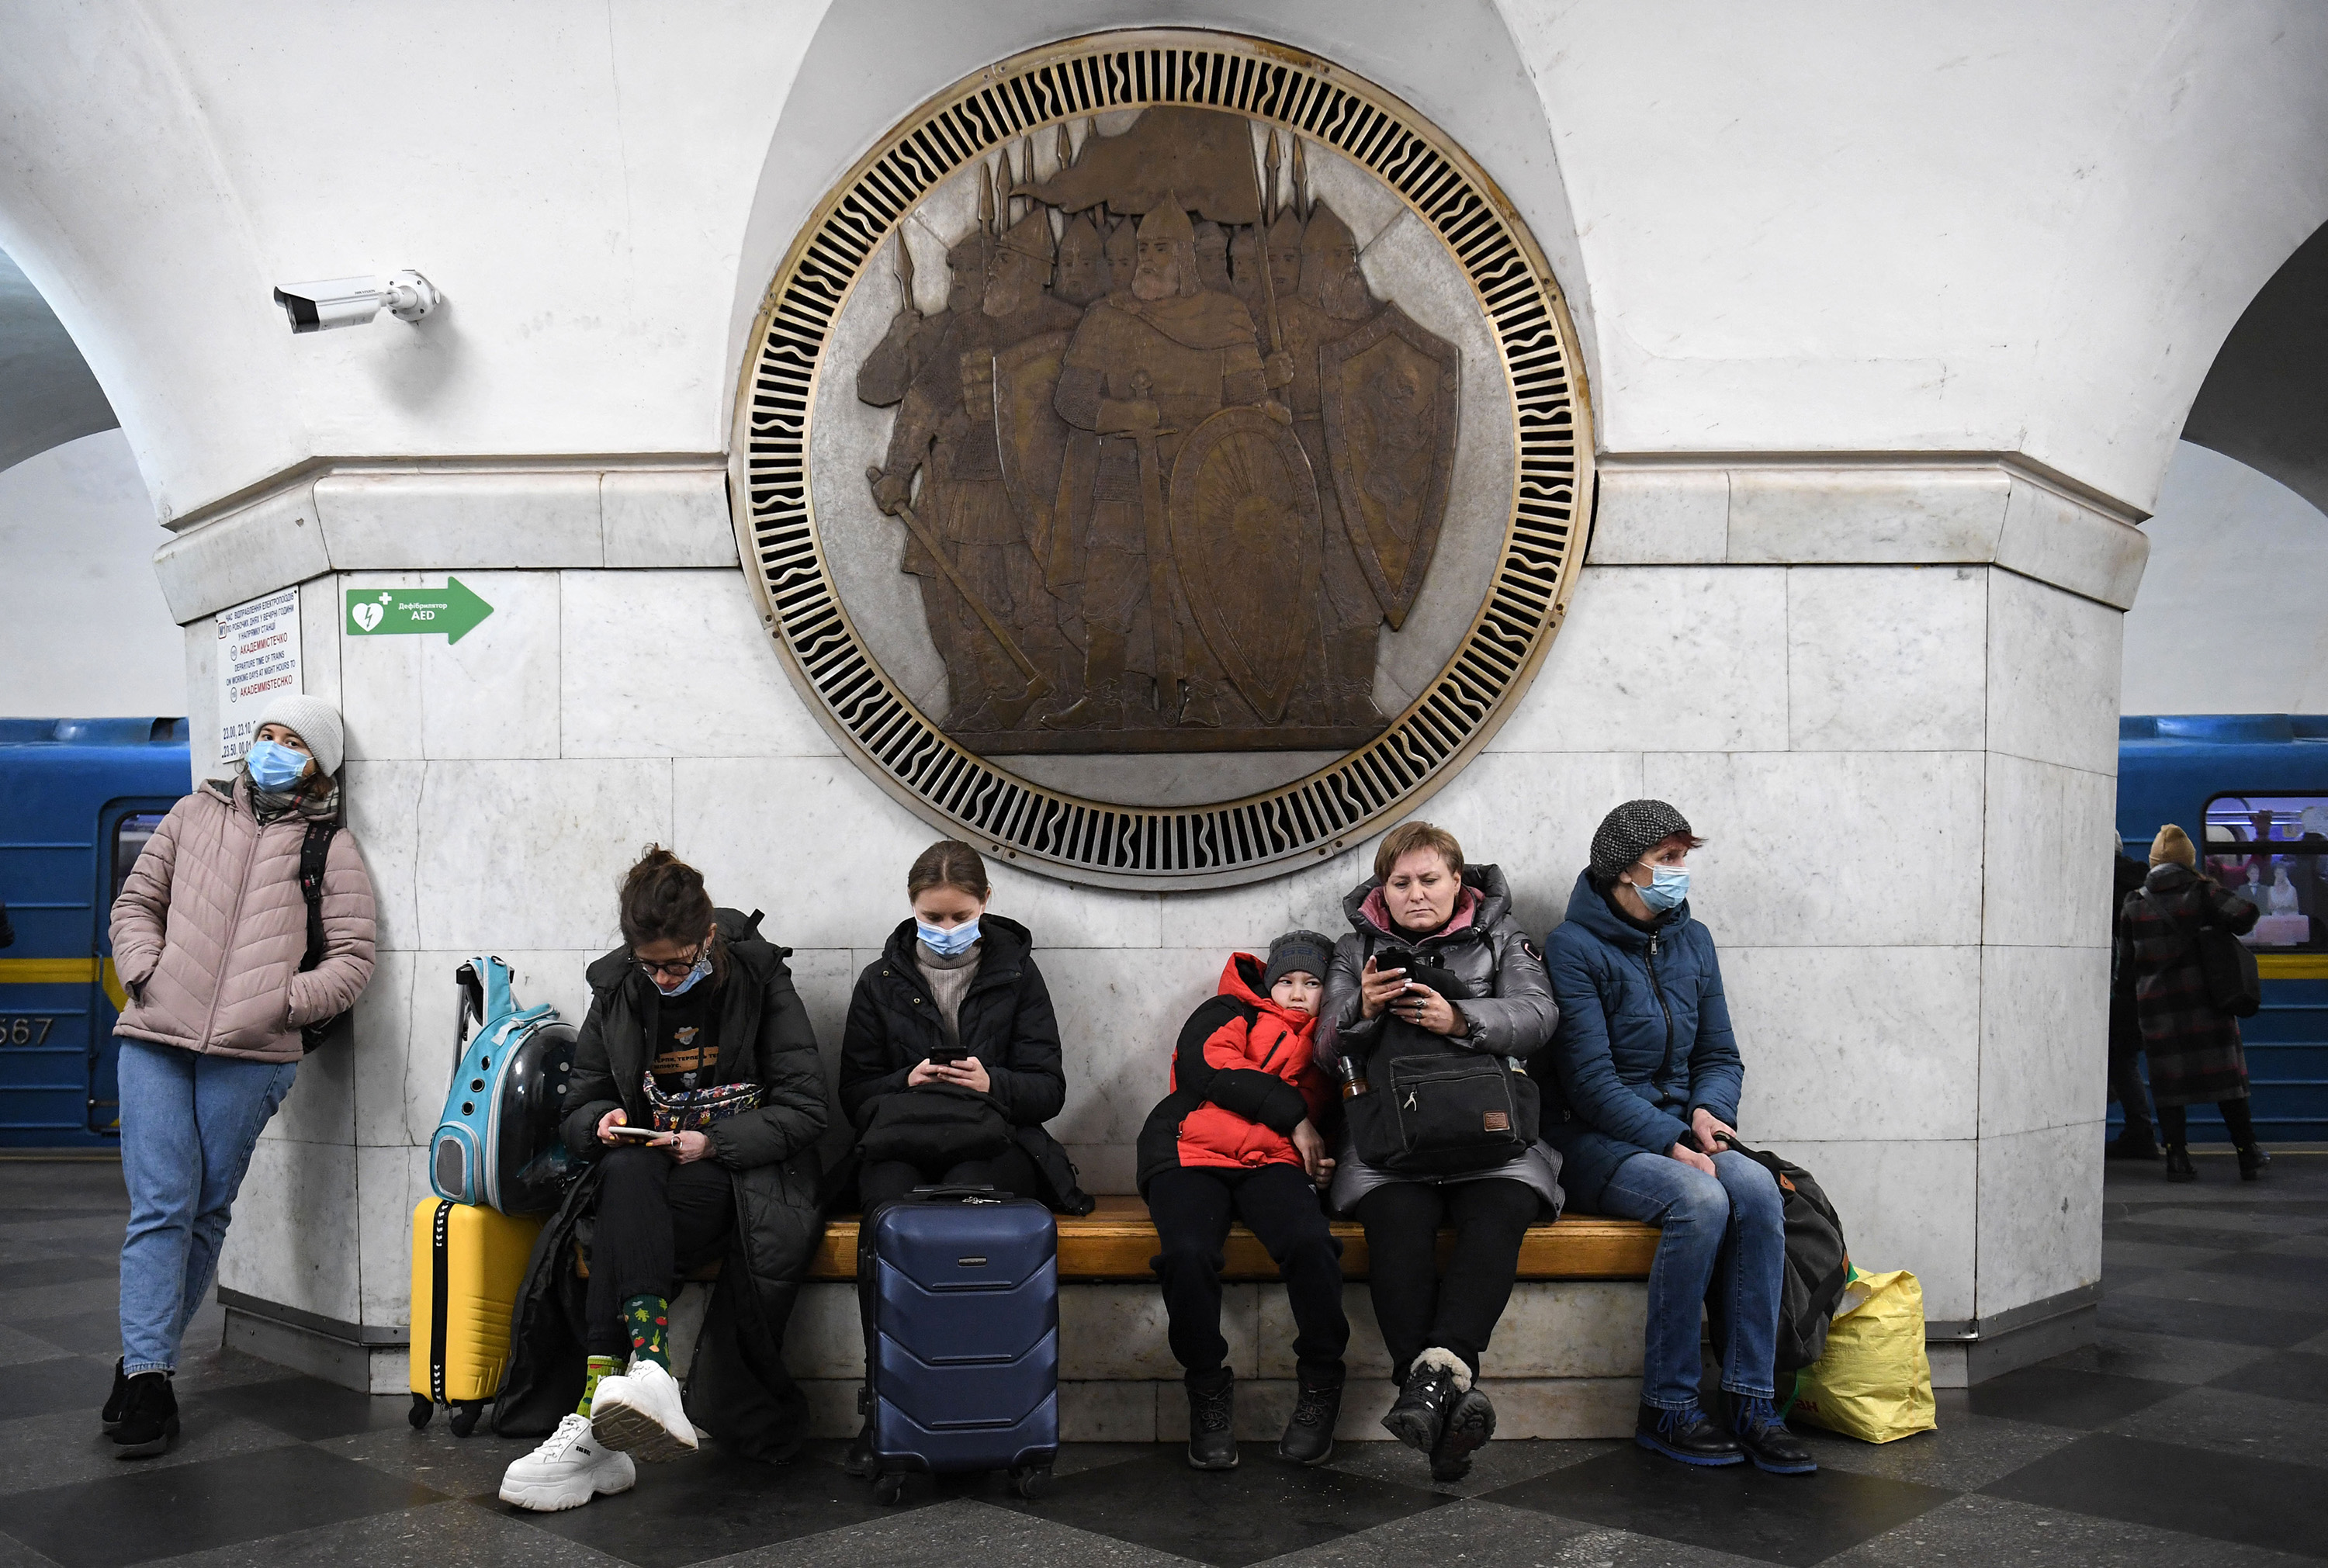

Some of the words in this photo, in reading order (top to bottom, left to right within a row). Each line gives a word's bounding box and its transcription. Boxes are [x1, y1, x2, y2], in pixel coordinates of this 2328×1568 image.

[234, 603, 262, 619] ВІДПРАВЛЕННЯ
[262, 592, 294, 610] ЕЛЕКТРОПОЇЗДІВ
[398, 602, 448, 611] Дефібрилятор
[411, 611, 435, 621] AED
[232, 620, 249, 631] РОБОЧИХ
[250, 616, 260, 626] ДНЯХ
[263, 610, 278, 621] ВЕЧІРНІ
[279, 604, 294, 616] ГОДИНИ
[240, 632, 288, 655] АКАДЕММІСТЕЧКО
[241, 627, 260, 639] НАПРЯМКУ
[232, 673, 248, 684] WORKING
[249, 670, 258, 680] DAYS
[259, 668, 264, 677] AT
[265, 665, 275, 675] NIGHT
[276, 661, 289, 672] HOURS
[290, 659, 296, 668] TO
[234, 659, 255, 672] DEPARTURE
[265, 654, 270, 663] OF
[271, 650, 285, 660] TRAINS
[240, 674, 293, 697] AKADEMMISTECHKO
